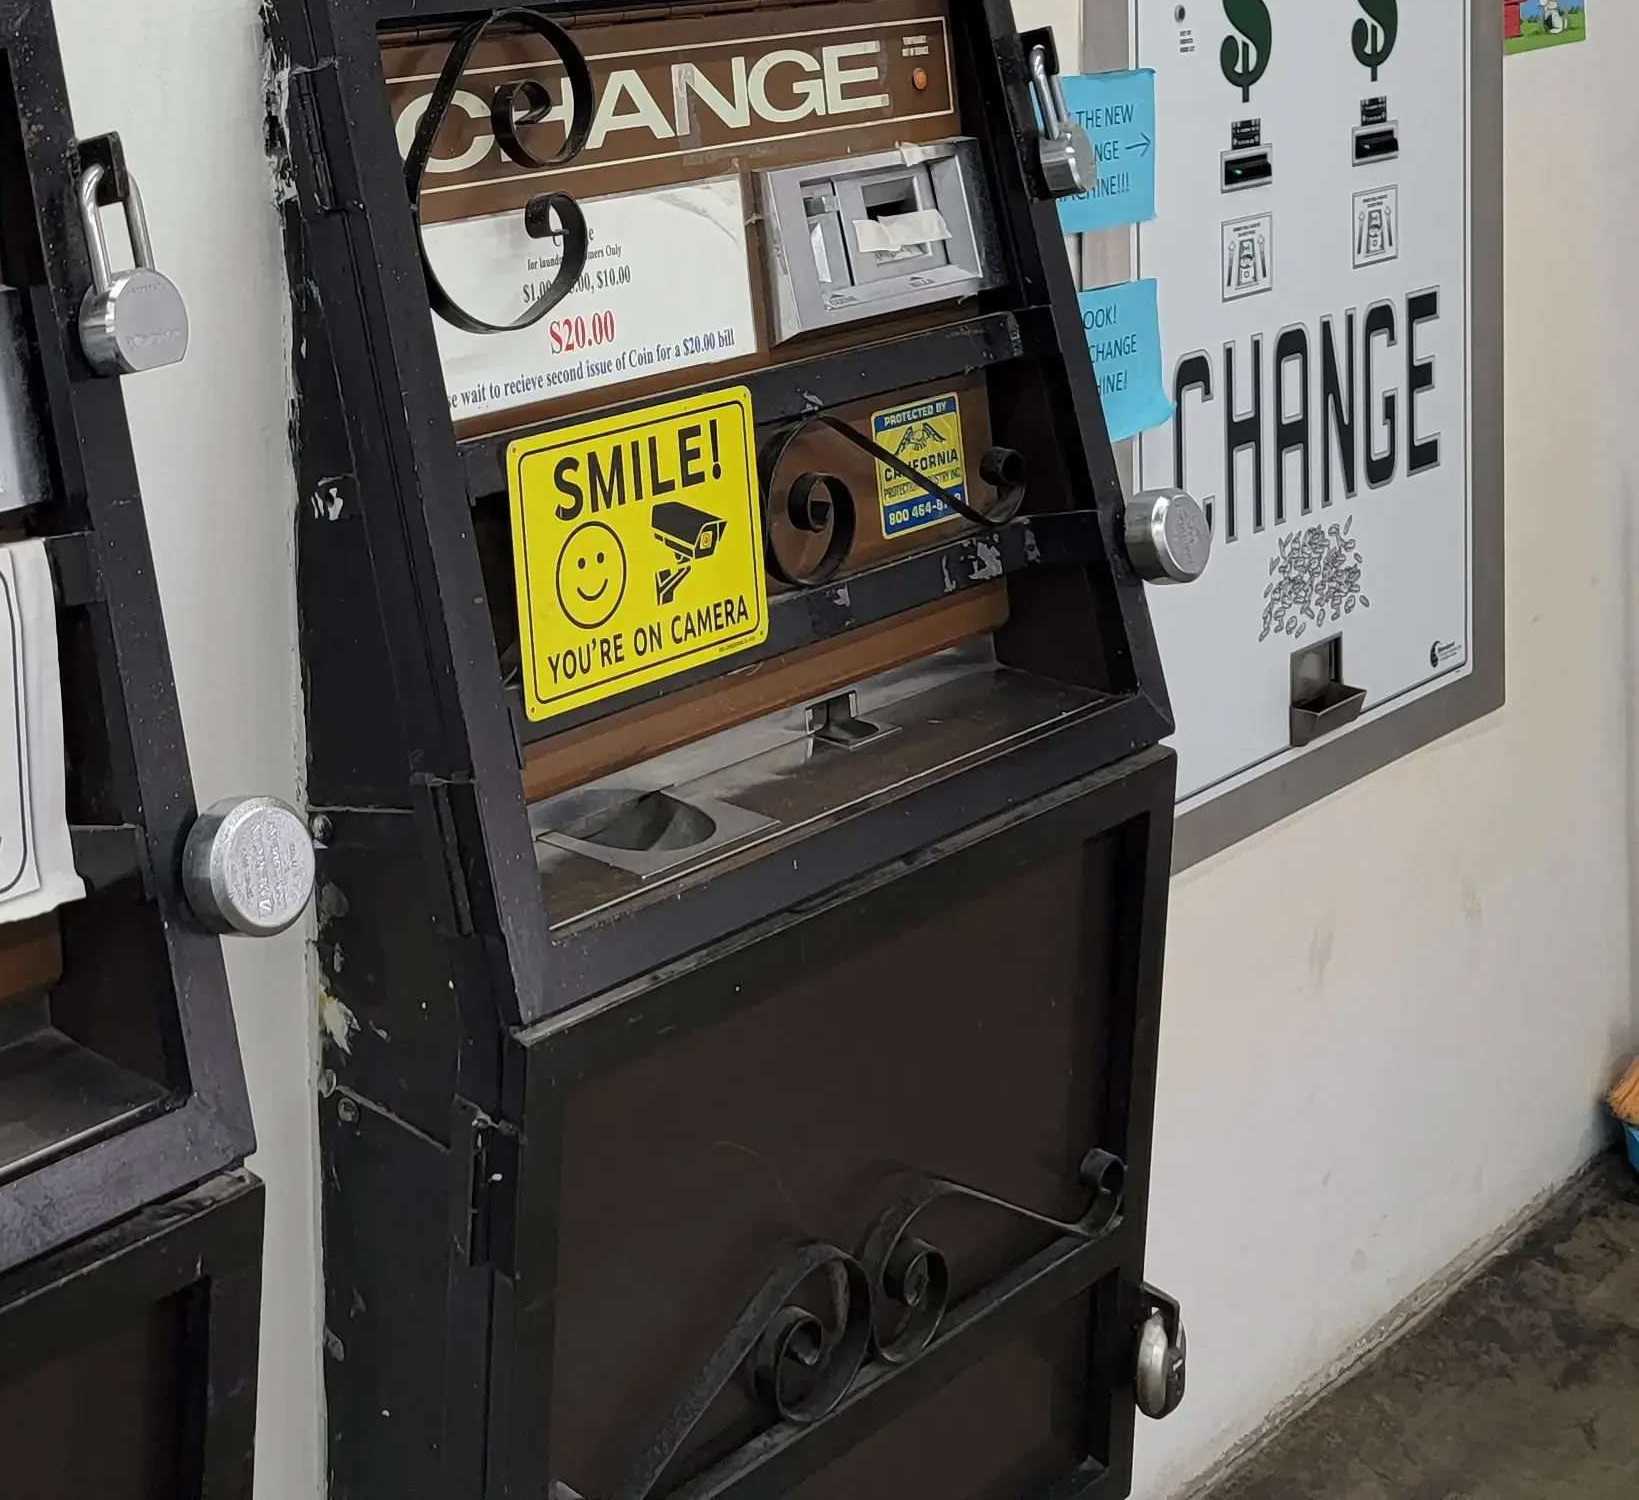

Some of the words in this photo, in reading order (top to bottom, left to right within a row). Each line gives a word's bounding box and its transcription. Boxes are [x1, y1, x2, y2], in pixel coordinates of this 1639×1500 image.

[1075, 108, 1102, 130] THE
[1104, 104, 1134, 126] NEW
[526, 257, 538, 270] for
[605, 244, 622, 260] Only
[597, 264, 631, 289] $10.00
[460, 382, 487, 407] wait
[489, 381, 501, 399] to
[503, 370, 544, 397] recieve
[546, 362, 584, 387] second
[586, 356, 613, 379] issue
[616, 351, 627, 371] of
[628, 345, 654, 368] Coin
[656, 342, 672, 362] for
[674, 346, 681, 358] a
[683, 333, 716, 357] $20.00
[717, 327, 736, 348] bill
[884, 406, 934, 427] PROTECTED
[935, 401, 947, 414] BY
[1170, 284, 1441, 544] CHANGE
[553, 419, 722, 522] SMILE!
[888, 509, 910, 526] 800
[547, 632, 625, 684] YOU'RE
[633, 620, 663, 656] ON
[671, 595, 749, 644] CAMERA
